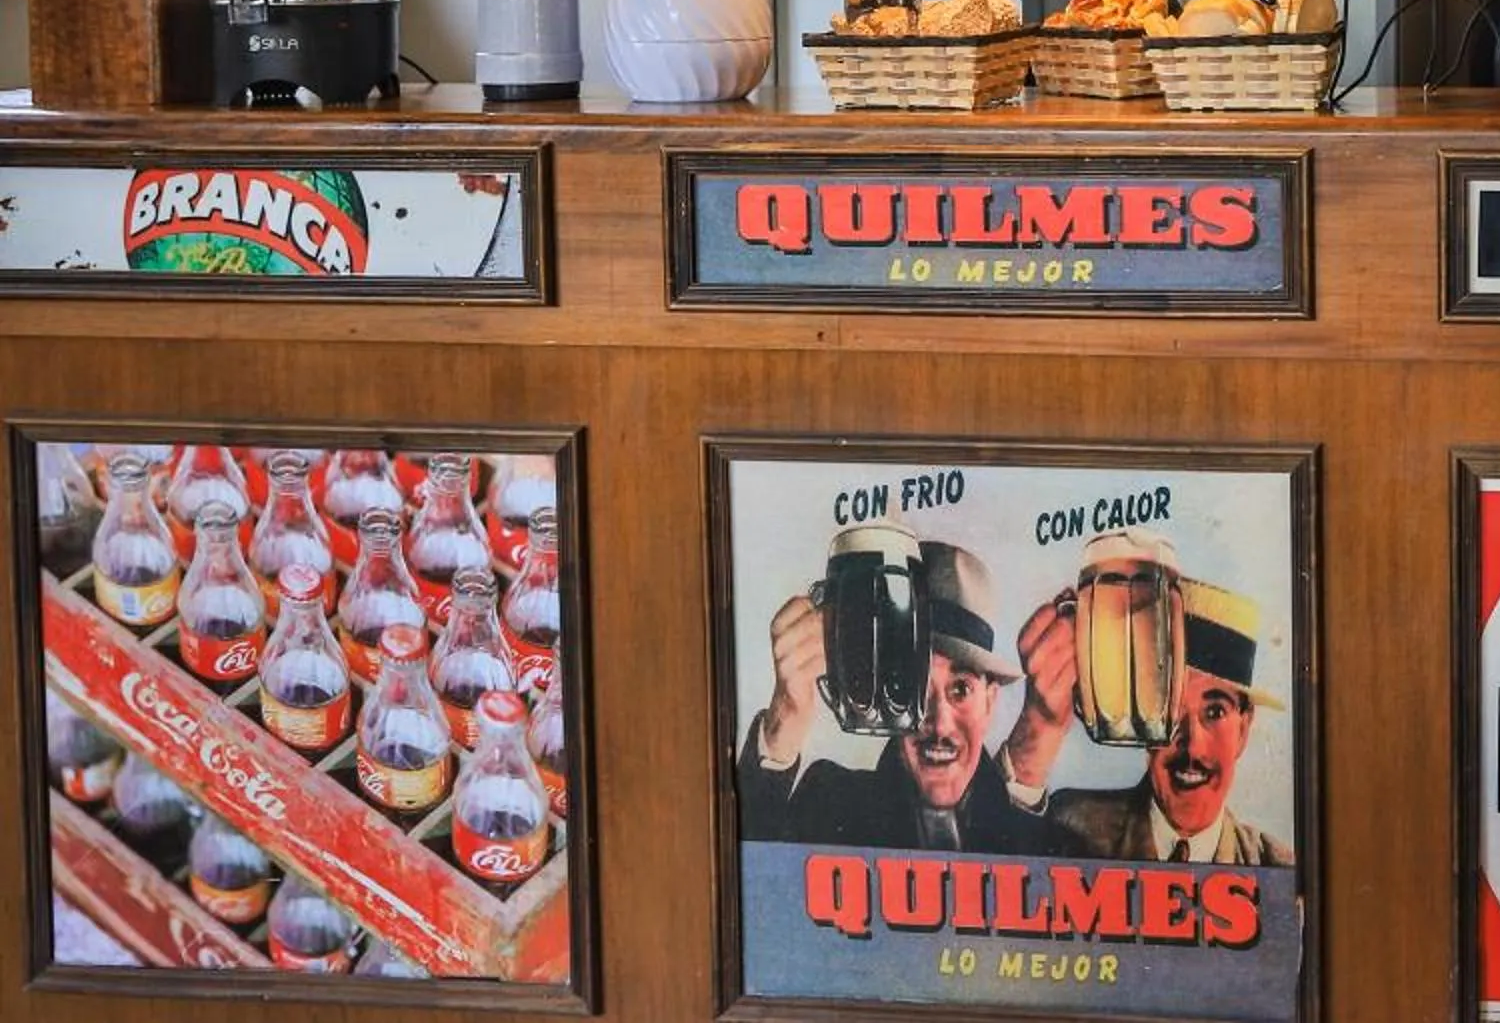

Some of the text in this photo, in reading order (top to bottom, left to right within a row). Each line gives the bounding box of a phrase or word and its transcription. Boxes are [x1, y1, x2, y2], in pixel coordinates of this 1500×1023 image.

[129, 173, 352, 274] BRANCA
[736, 183, 1259, 255] QUILMES
[887, 257, 1095, 283] LO MEJOR
[835, 471, 964, 526] CON FRIO
[1036, 486, 1171, 546] CON CALOR
[805, 854, 1264, 951] QUILMES
[939, 948, 1119, 983] LO MEJOR
